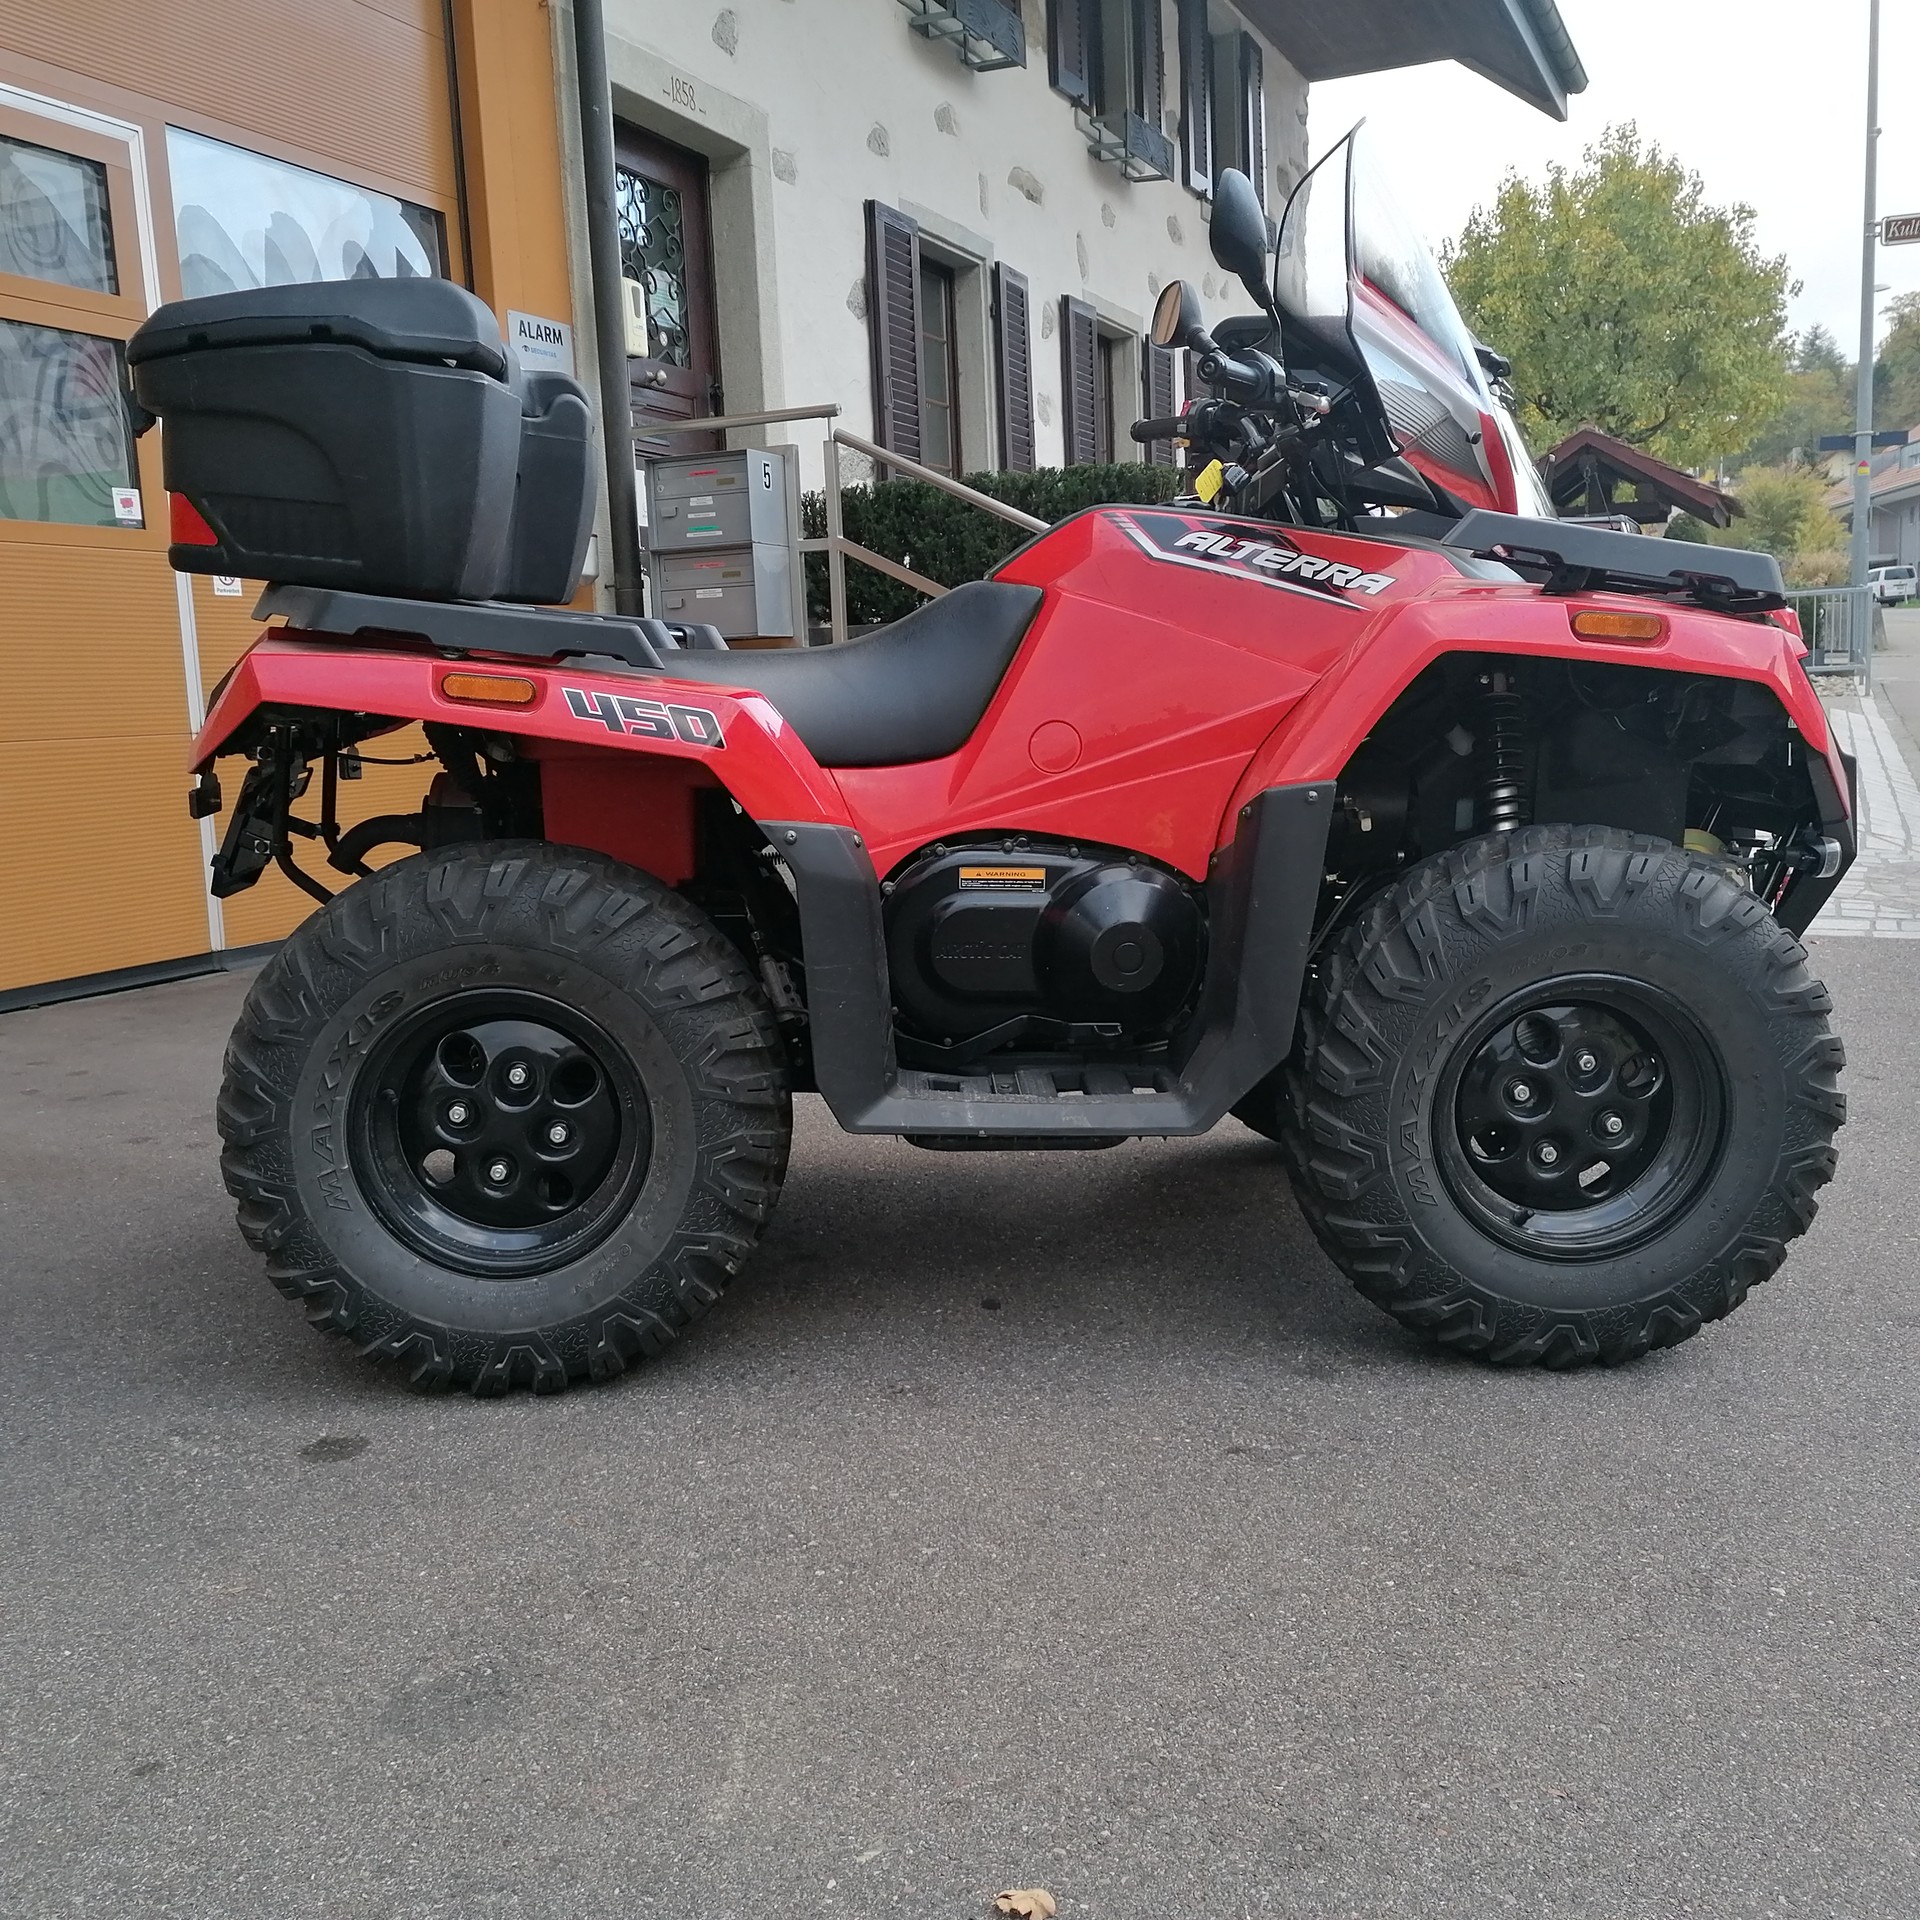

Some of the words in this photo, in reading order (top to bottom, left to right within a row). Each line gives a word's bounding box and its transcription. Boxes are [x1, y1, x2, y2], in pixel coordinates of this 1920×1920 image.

[519, 319, 564, 346] ALARM
[762, 462, 771, 489] 5
[1173, 530, 1398, 596] ALTERRA
[561, 687, 727, 750] 450
[311, 990, 405, 1212] MAXXIS
[1401, 975, 1493, 1207] MAXXIS
